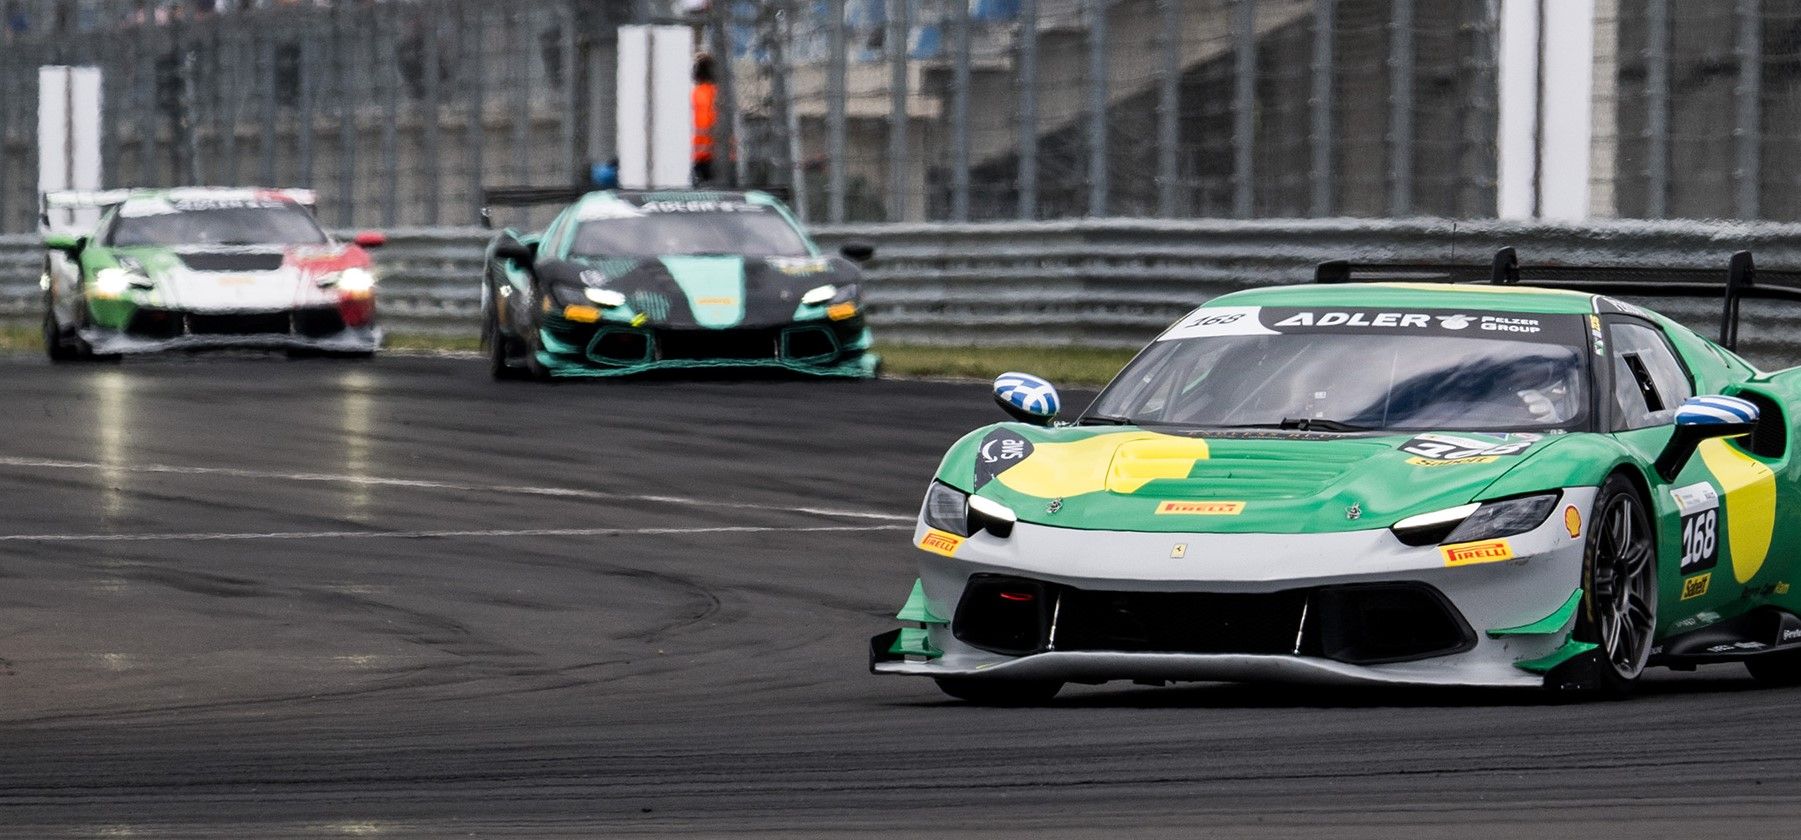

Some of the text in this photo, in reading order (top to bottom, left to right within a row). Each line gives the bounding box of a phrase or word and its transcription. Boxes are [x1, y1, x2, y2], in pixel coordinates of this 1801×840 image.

[1184, 314, 1246, 328] 168
[1273, 312, 1430, 327] ADLER
[1481, 316, 1539, 325] PELZER
[1481, 323, 1541, 332] GROUP
[1001, 439, 1024, 459] aws
[922, 532, 959, 551] PIRELLI
[1681, 509, 1716, 568] 168
[1446, 543, 1507, 561] PIRELLI
